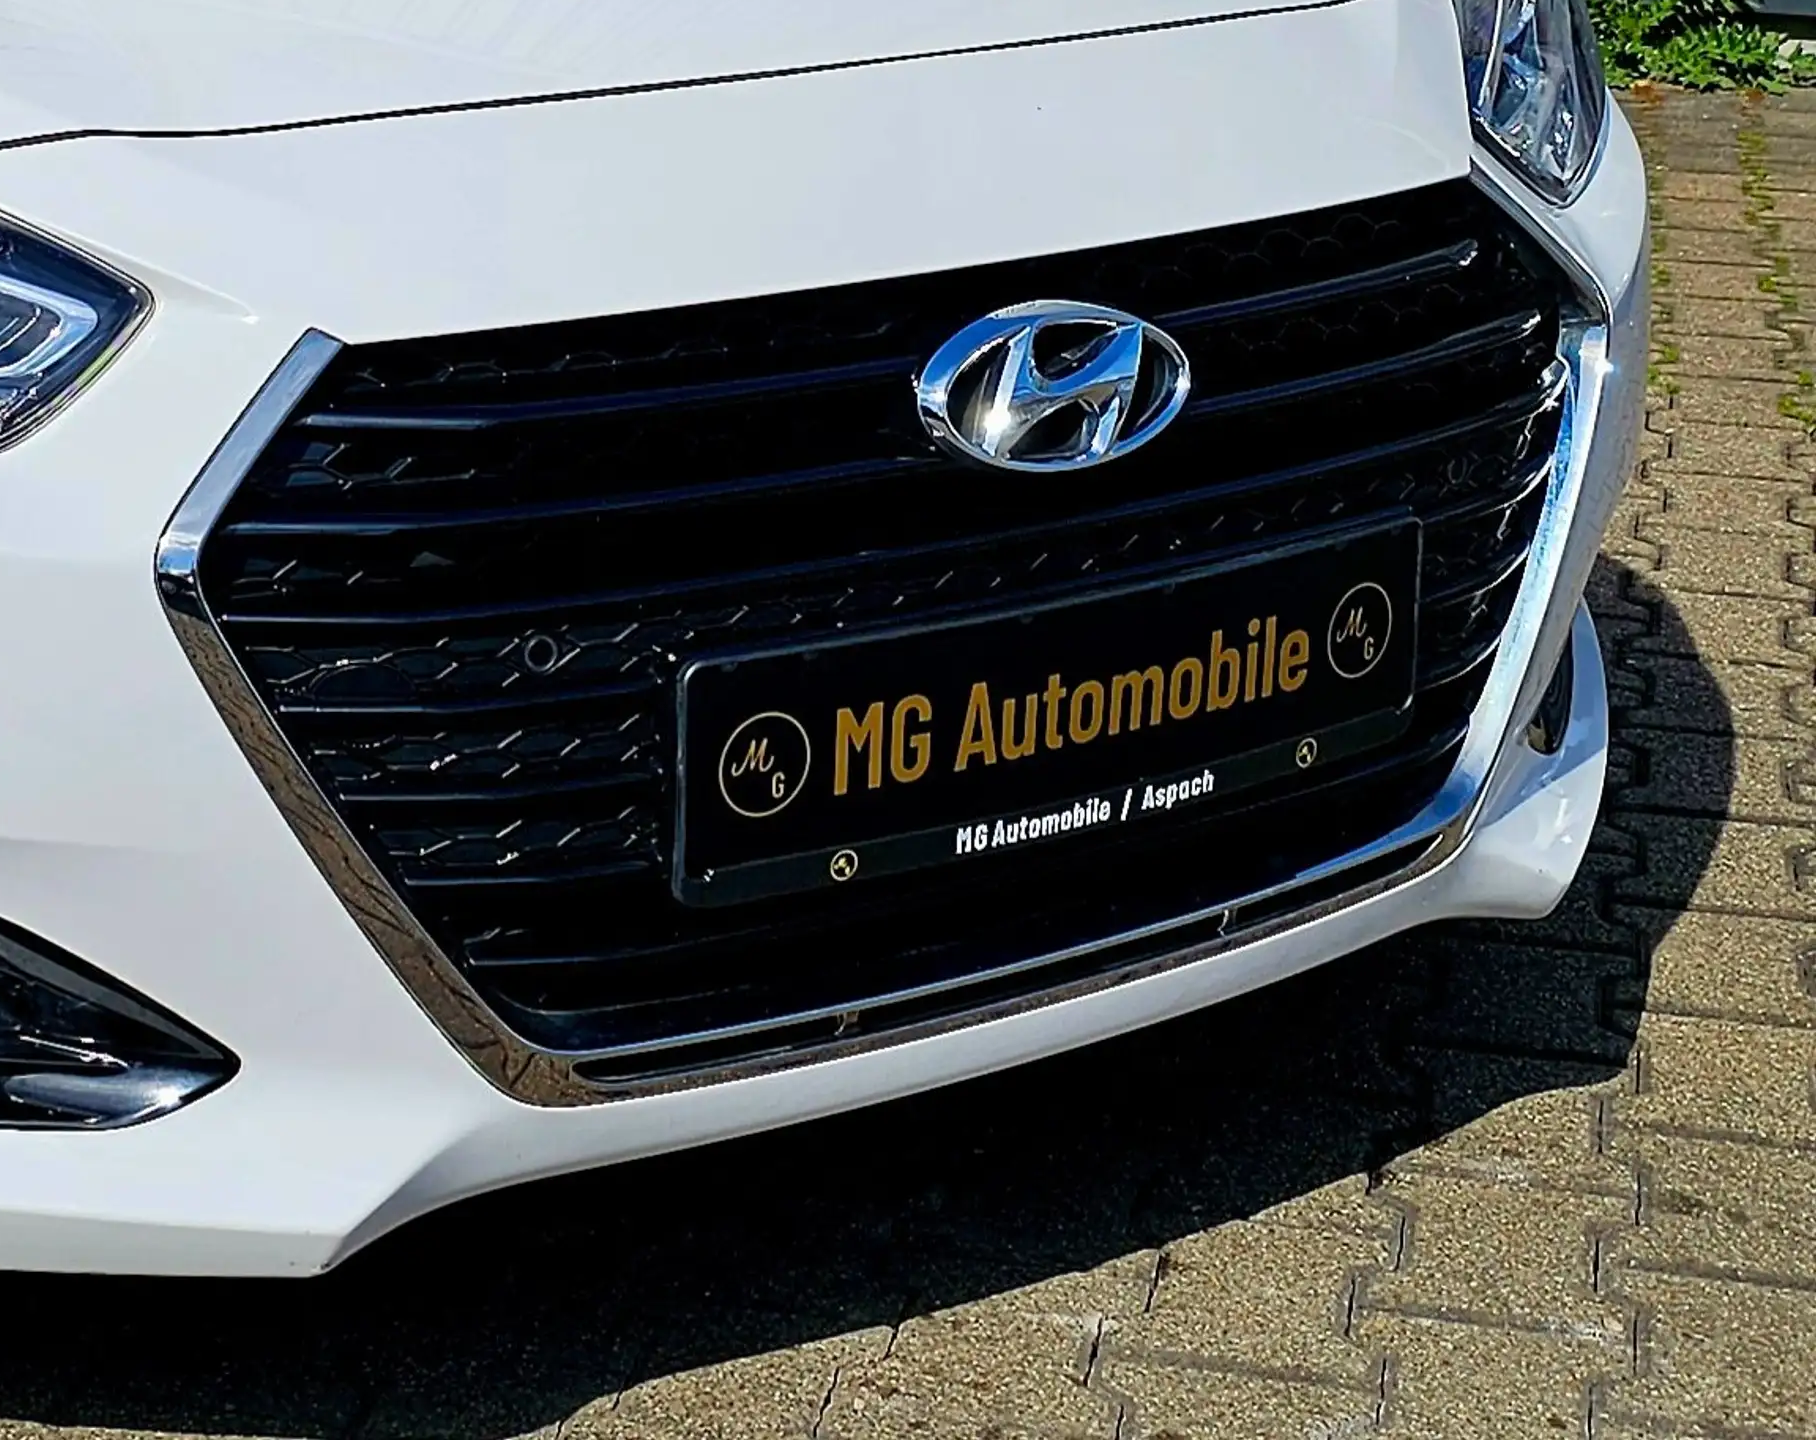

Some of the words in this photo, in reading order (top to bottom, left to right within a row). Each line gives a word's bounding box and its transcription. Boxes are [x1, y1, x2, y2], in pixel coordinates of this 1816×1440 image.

[833, 693, 932, 796] MG
[953, 615, 1310, 772] Automobile
[955, 824, 989, 855] MG
[991, 796, 1111, 848] Automobile
[1140, 769, 1215, 810] Aspach
